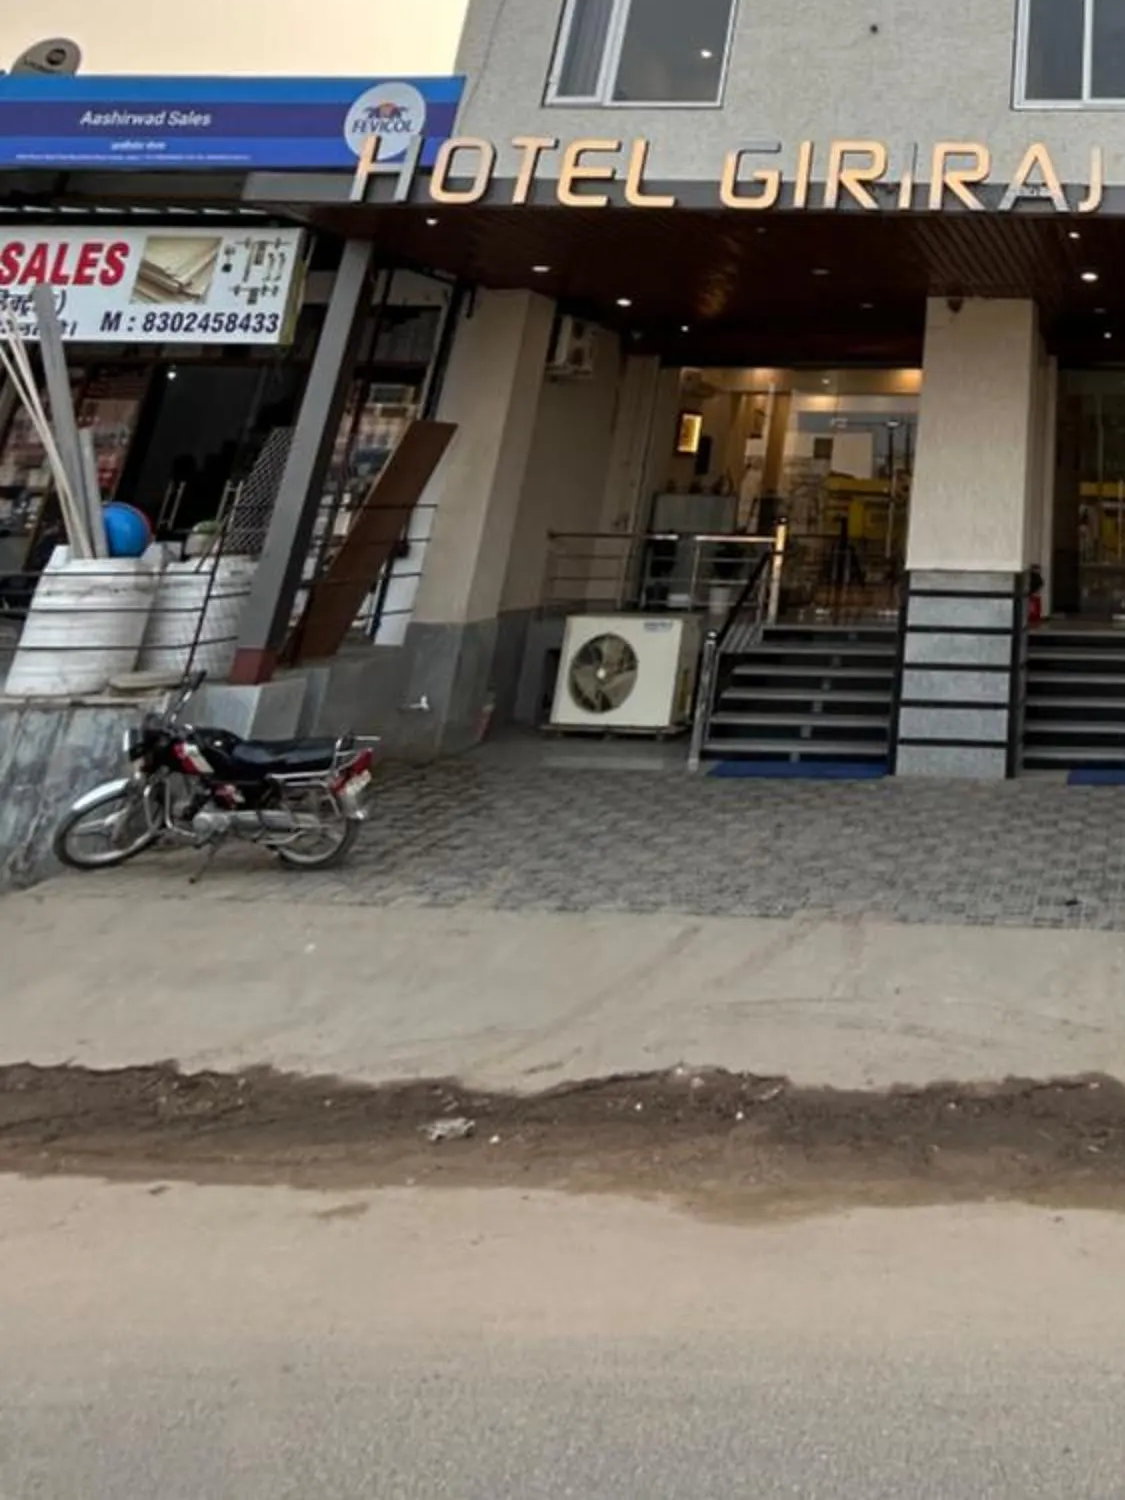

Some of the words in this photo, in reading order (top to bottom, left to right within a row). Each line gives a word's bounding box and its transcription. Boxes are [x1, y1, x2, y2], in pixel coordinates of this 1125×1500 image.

[80, 110, 165, 127] Aashirwad
[168, 111, 212, 127] Sales
[352, 119, 413, 134] FEVICOL
[349, 134, 677, 208] HOTEL
[719, 139, 1104, 213] GIRIRAJ
[0, 242, 130, 287] SALES
[141, 311, 281, 334] 8302458433
